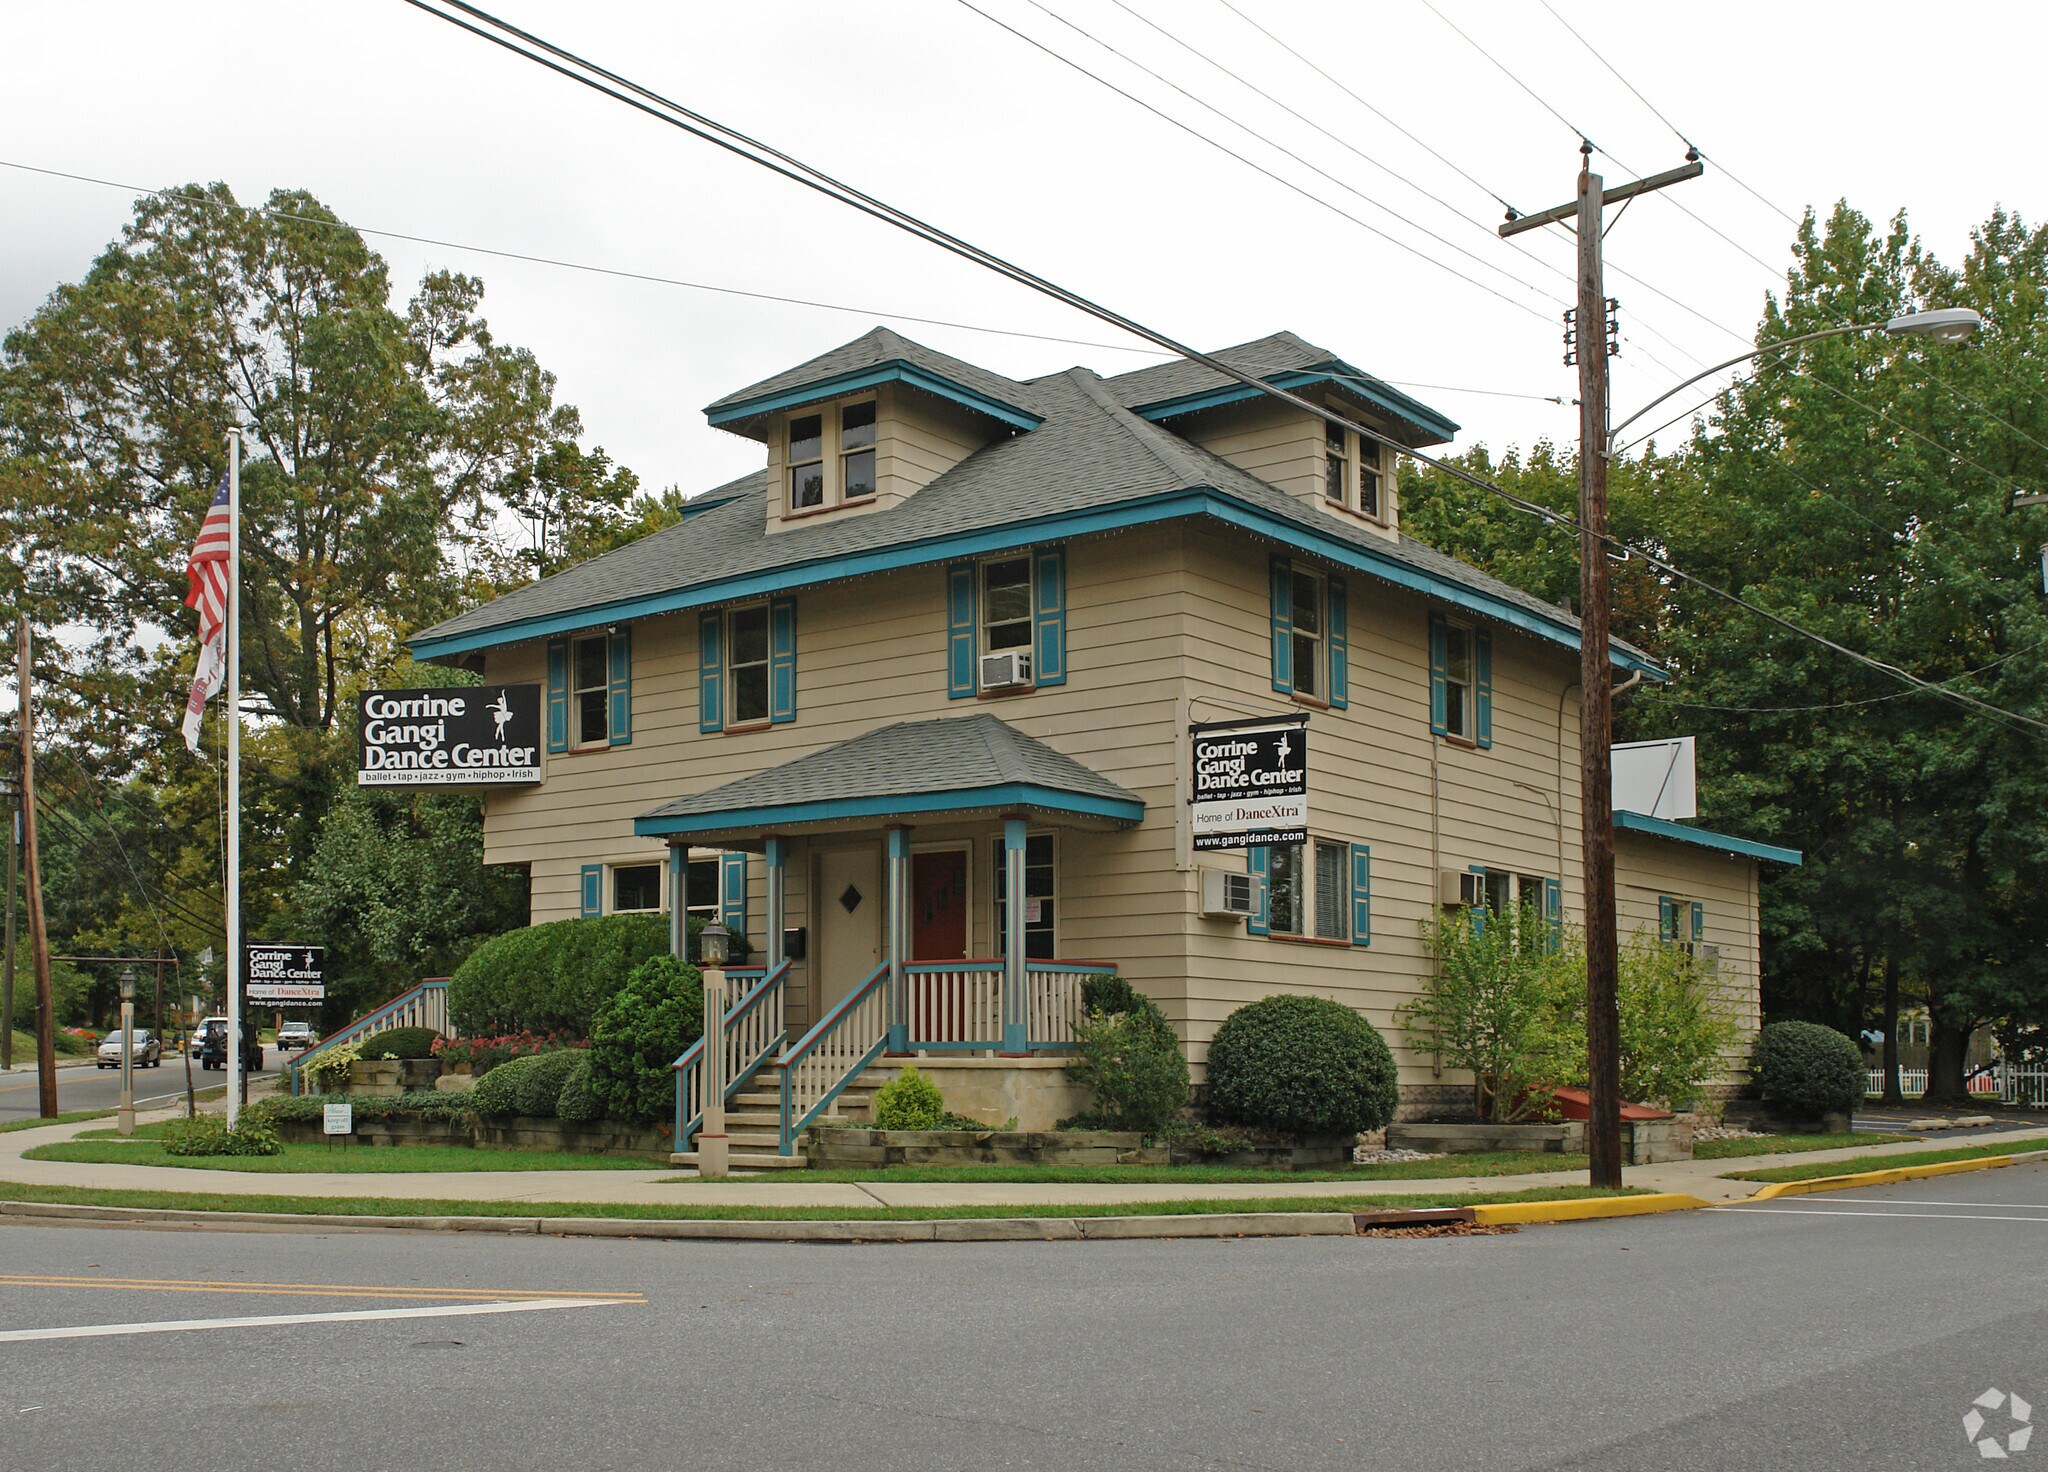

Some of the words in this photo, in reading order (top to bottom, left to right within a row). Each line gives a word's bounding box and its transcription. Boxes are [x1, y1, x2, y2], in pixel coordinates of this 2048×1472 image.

[365, 694, 466, 719] Corrine
[365, 719, 446, 750] Gangi
[365, 746, 449, 770] Dance
[452, 743, 535, 767] Center
[1197, 740, 1258, 759] Corrine
[1197, 755, 1246, 776] Gangi
[366, 773, 391, 781] ballet
[398, 773, 412, 782] tap
[419, 772, 439, 782] jazz
[446, 773, 466, 781] gym
[473, 771, 505, 780] hiphop
[512, 770, 533, 778] Irish
[1198, 773, 1249, 790] Dance
[1251, 768, 1303, 785] Center
[1217, 792, 1226, 800] tap
[1230, 791, 1242, 799] jazz
[1197, 813, 1222, 823] Home
[1225, 812, 1233, 821] of
[1236, 805, 1298, 820] DanceXtra
[1196, 832, 1304, 846] www.gangidance.com
[250, 950, 292, 960] Corrine
[250, 960, 284, 972] Gangi
[250, 968, 286, 978] Dance
[287, 968, 322, 978] Center
[277, 987, 320, 995] DanceXtra
